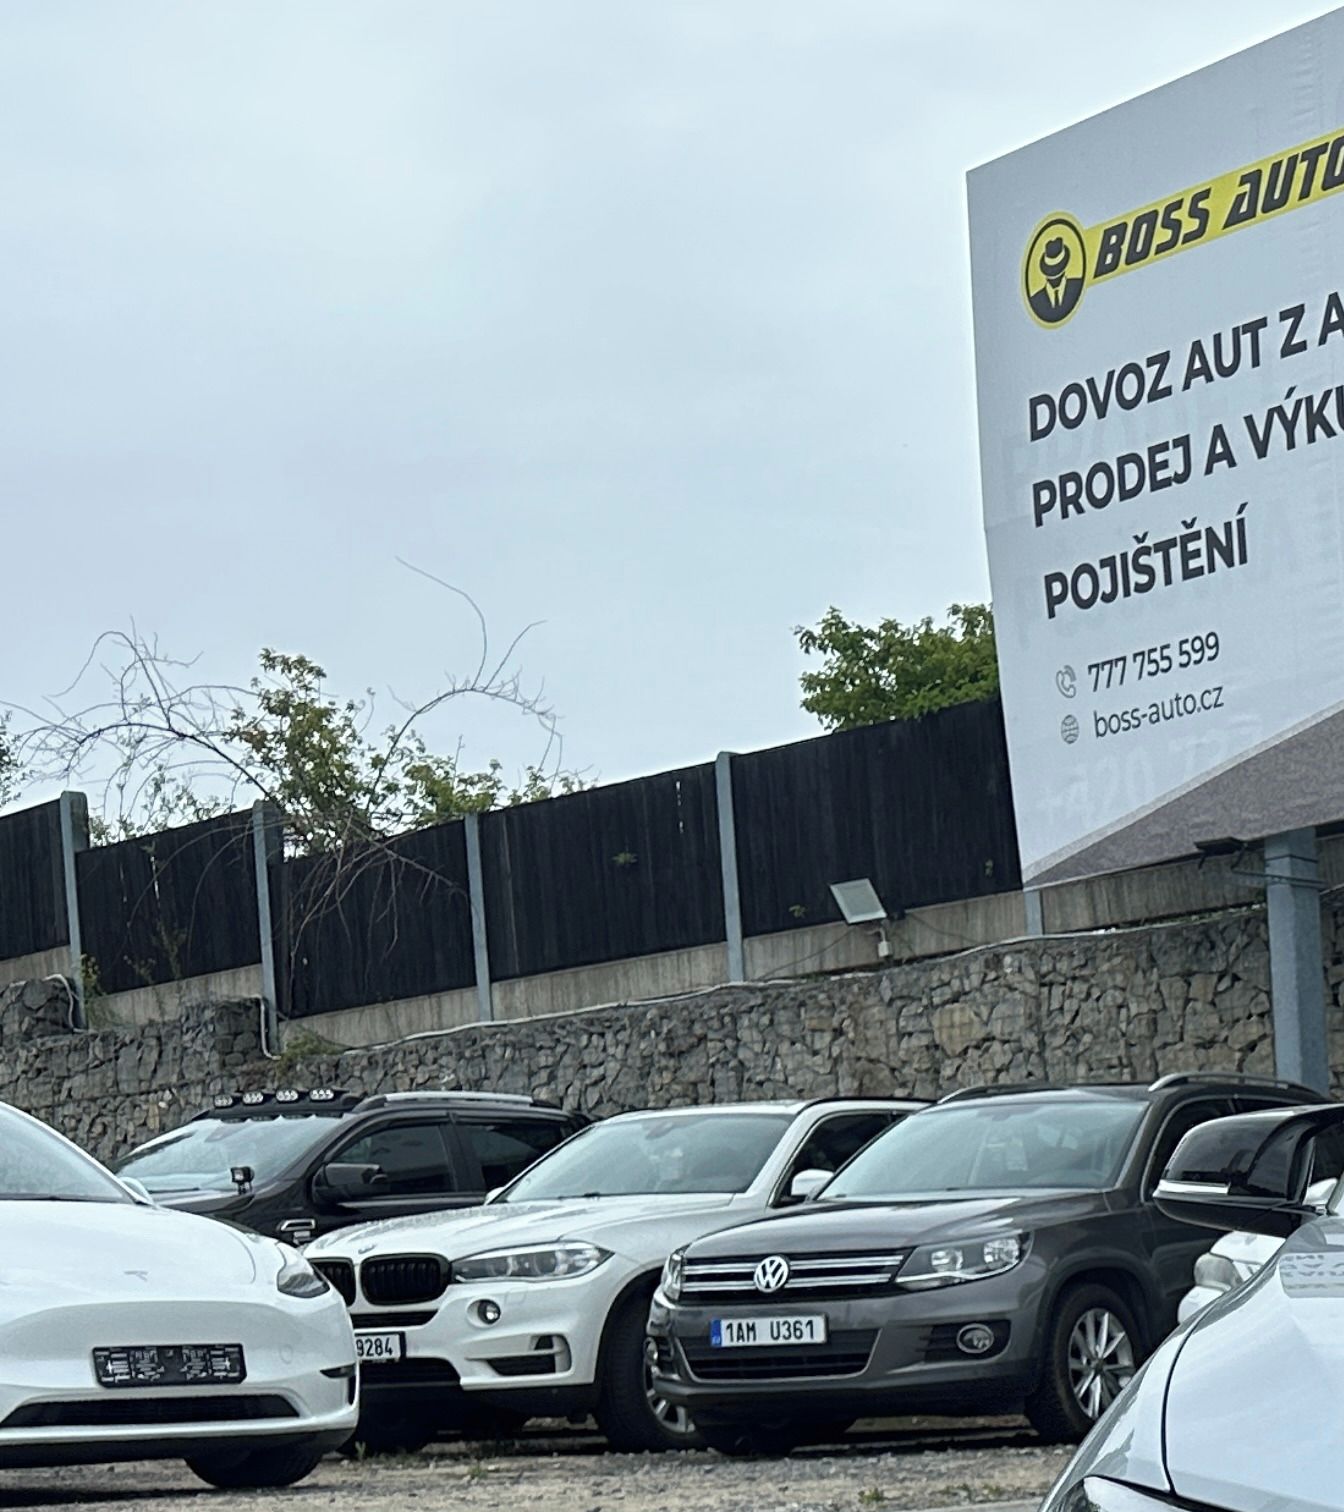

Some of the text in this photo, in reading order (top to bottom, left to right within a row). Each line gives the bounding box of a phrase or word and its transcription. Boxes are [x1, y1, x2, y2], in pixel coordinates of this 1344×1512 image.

[1093, 187, 1212, 280] BOSS
[1029, 350, 1173, 443] DOVOZ
[1181, 316, 1268, 392] AUT
[1279, 303, 1308, 359] Z
[1032, 433, 1192, 528] PRODEJ
[1204, 423, 1238, 476] A
[1044, 501, 1249, 620] POJIŠTĚNÍ
[1087, 631, 1220, 692] 777 755 599
[1093, 686, 1224, 738] boss-auto.cz
[355, 1337, 394, 1357] 9284
[725, 1322, 757, 1344] 1AM
[770, 1319, 815, 1342] U361
